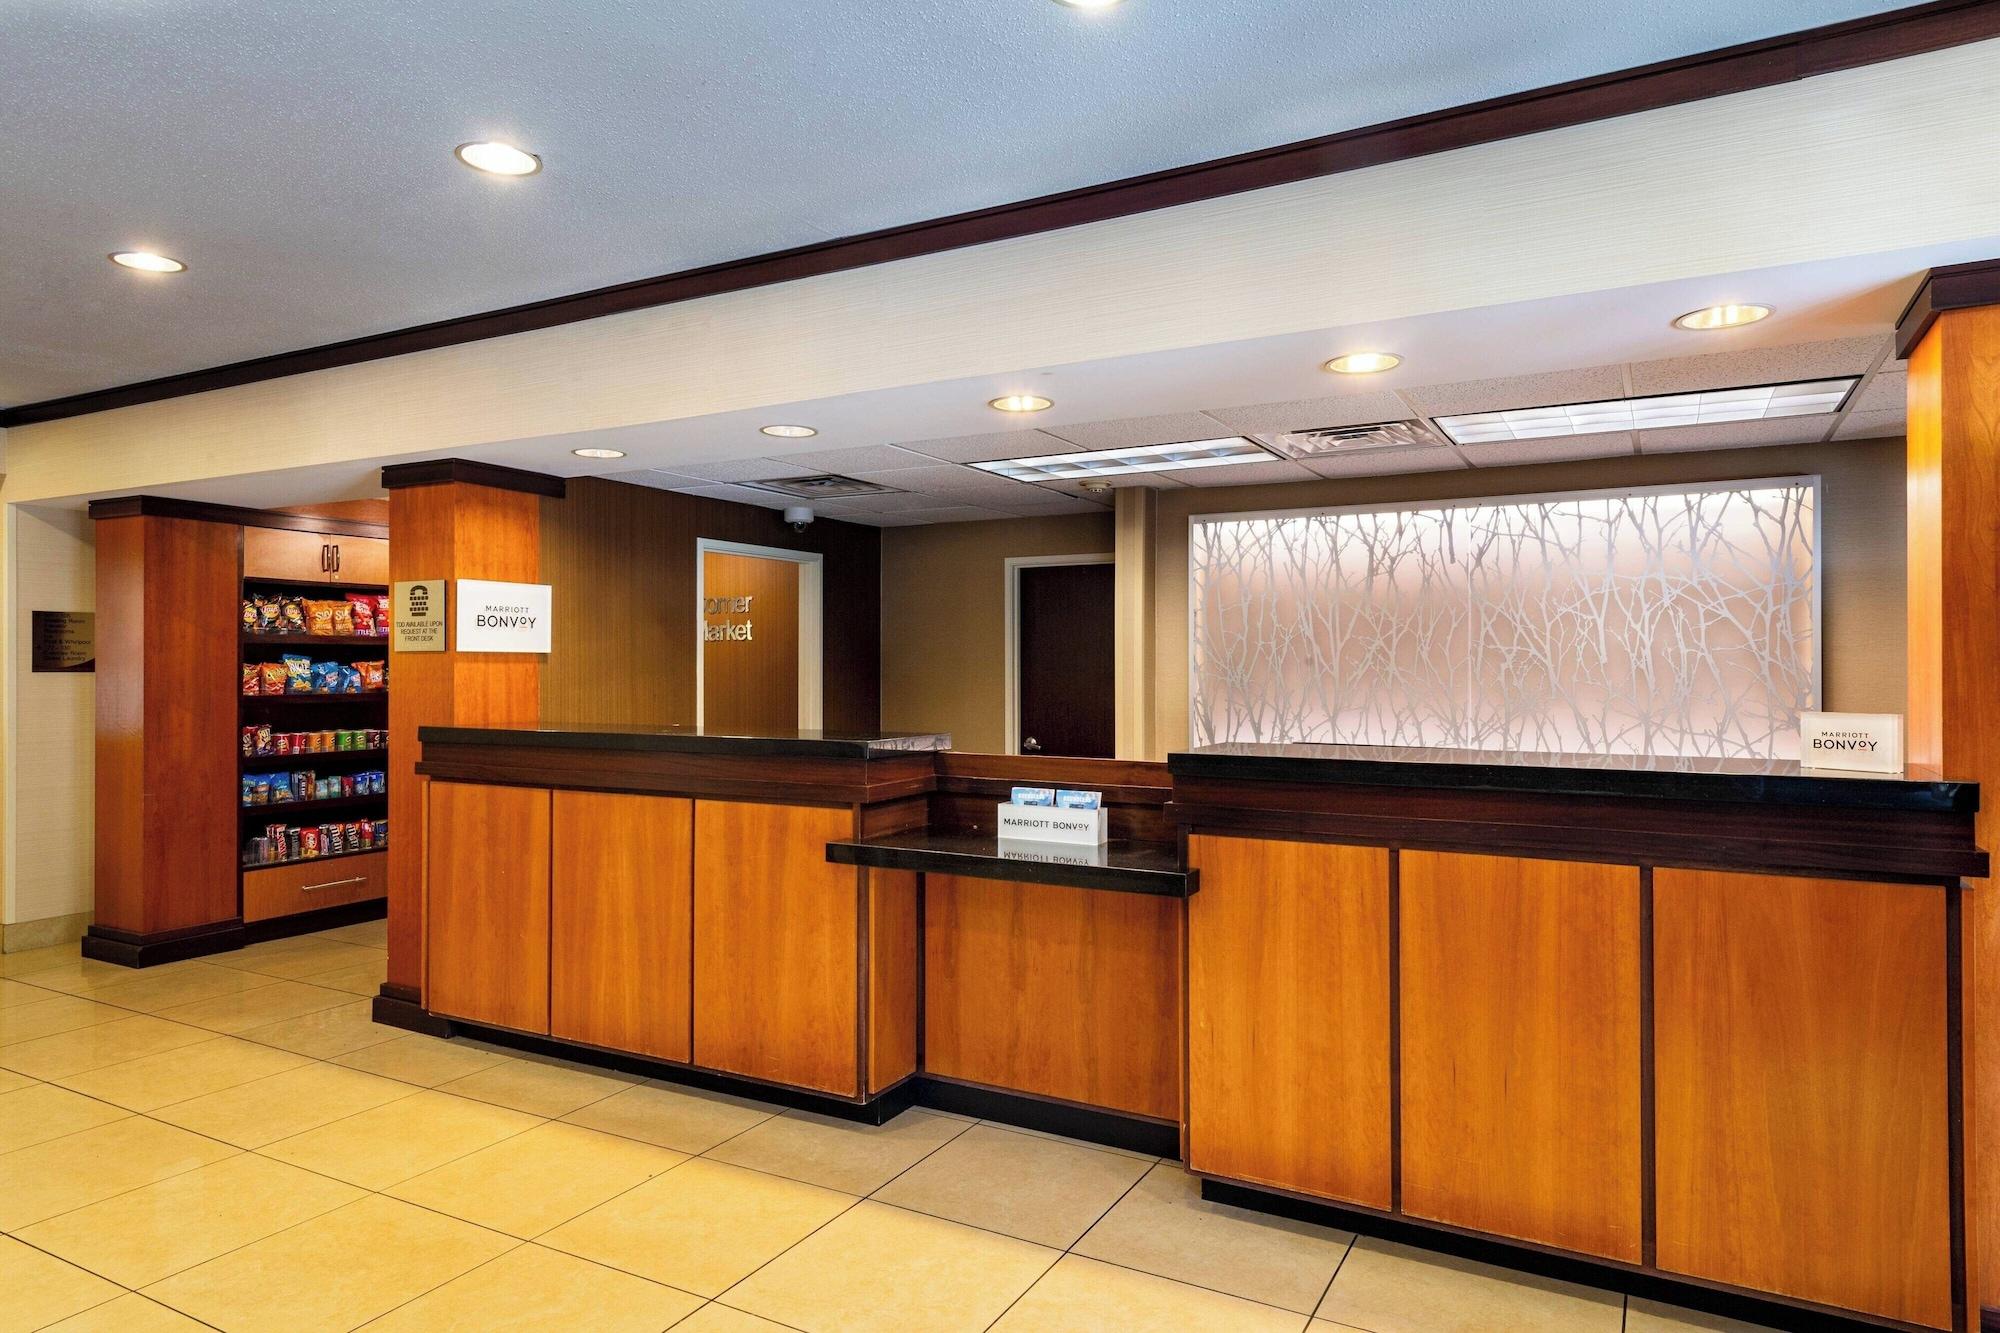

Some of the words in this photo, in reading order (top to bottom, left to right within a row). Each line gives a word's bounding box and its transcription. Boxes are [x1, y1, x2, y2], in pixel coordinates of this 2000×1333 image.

[485, 605, 529, 614] MARRIOTT
[703, 596, 753, 614] orner
[429, 620, 443, 628] UPON
[477, 615, 536, 629] BONVOY
[1821, 731, 1869, 739] MARRIOTT
[1813, 739, 1878, 751] BONVOY
[1003, 818, 1049, 828] MARRIOTT
[1052, 821, 1090, 831] BONVOY
